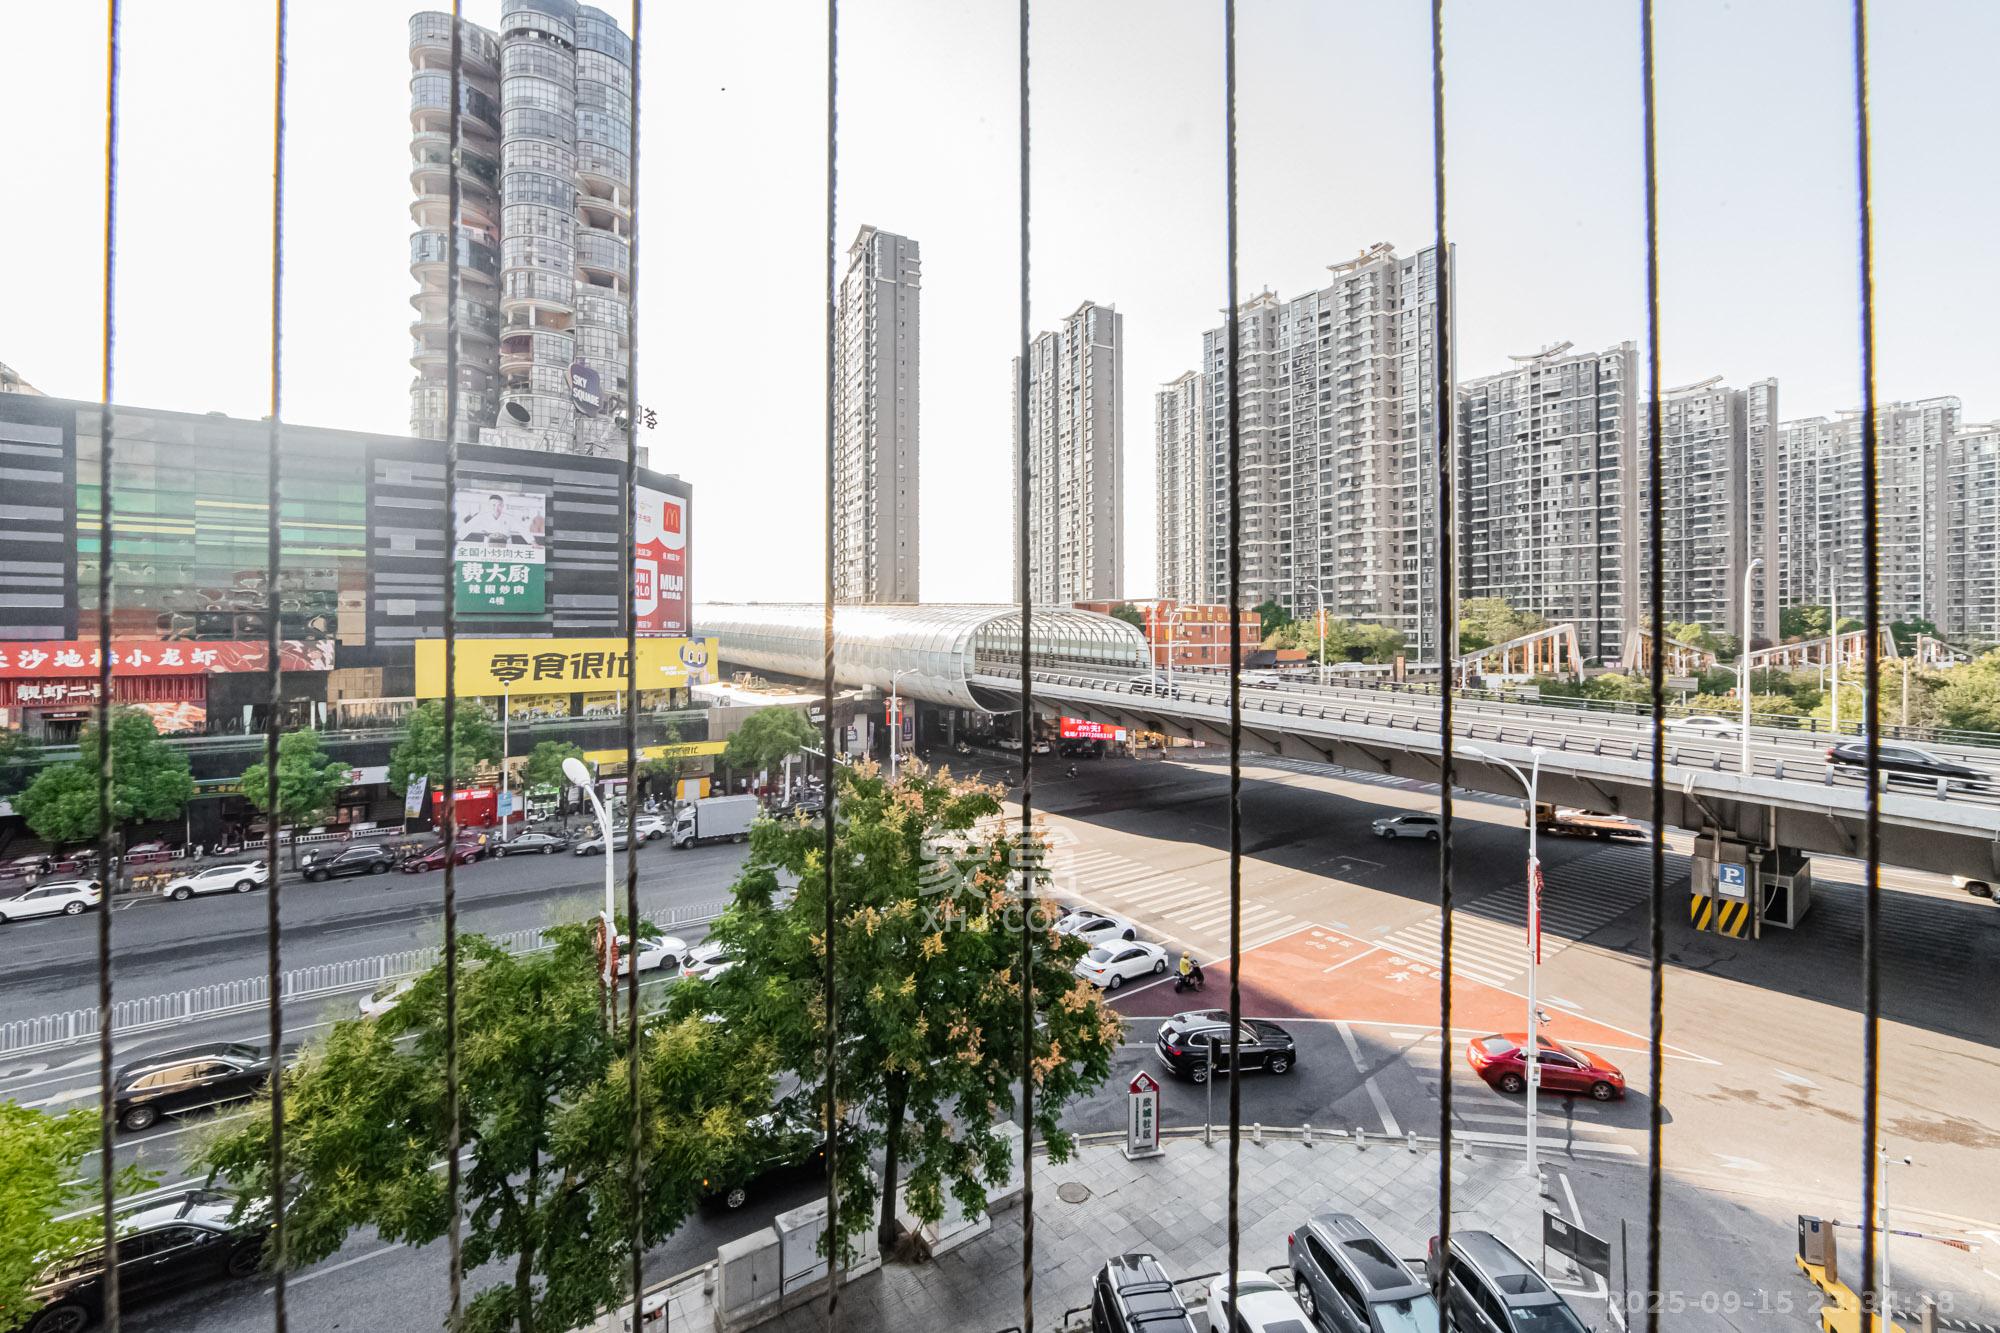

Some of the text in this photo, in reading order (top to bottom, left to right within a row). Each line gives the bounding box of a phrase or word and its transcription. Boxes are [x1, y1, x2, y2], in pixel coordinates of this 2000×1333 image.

[572, 374, 588, 389] SKY
[572, 387, 600, 407] SQUARE
[458, 547, 535, 559] 全国小炒肉大王
[462, 562, 530, 584] 费大厨
[468, 584, 525, 595] 辣椒炒肉
[660, 574, 684, 591] MUJI
[490, 652, 638, 682] 零食很忙
